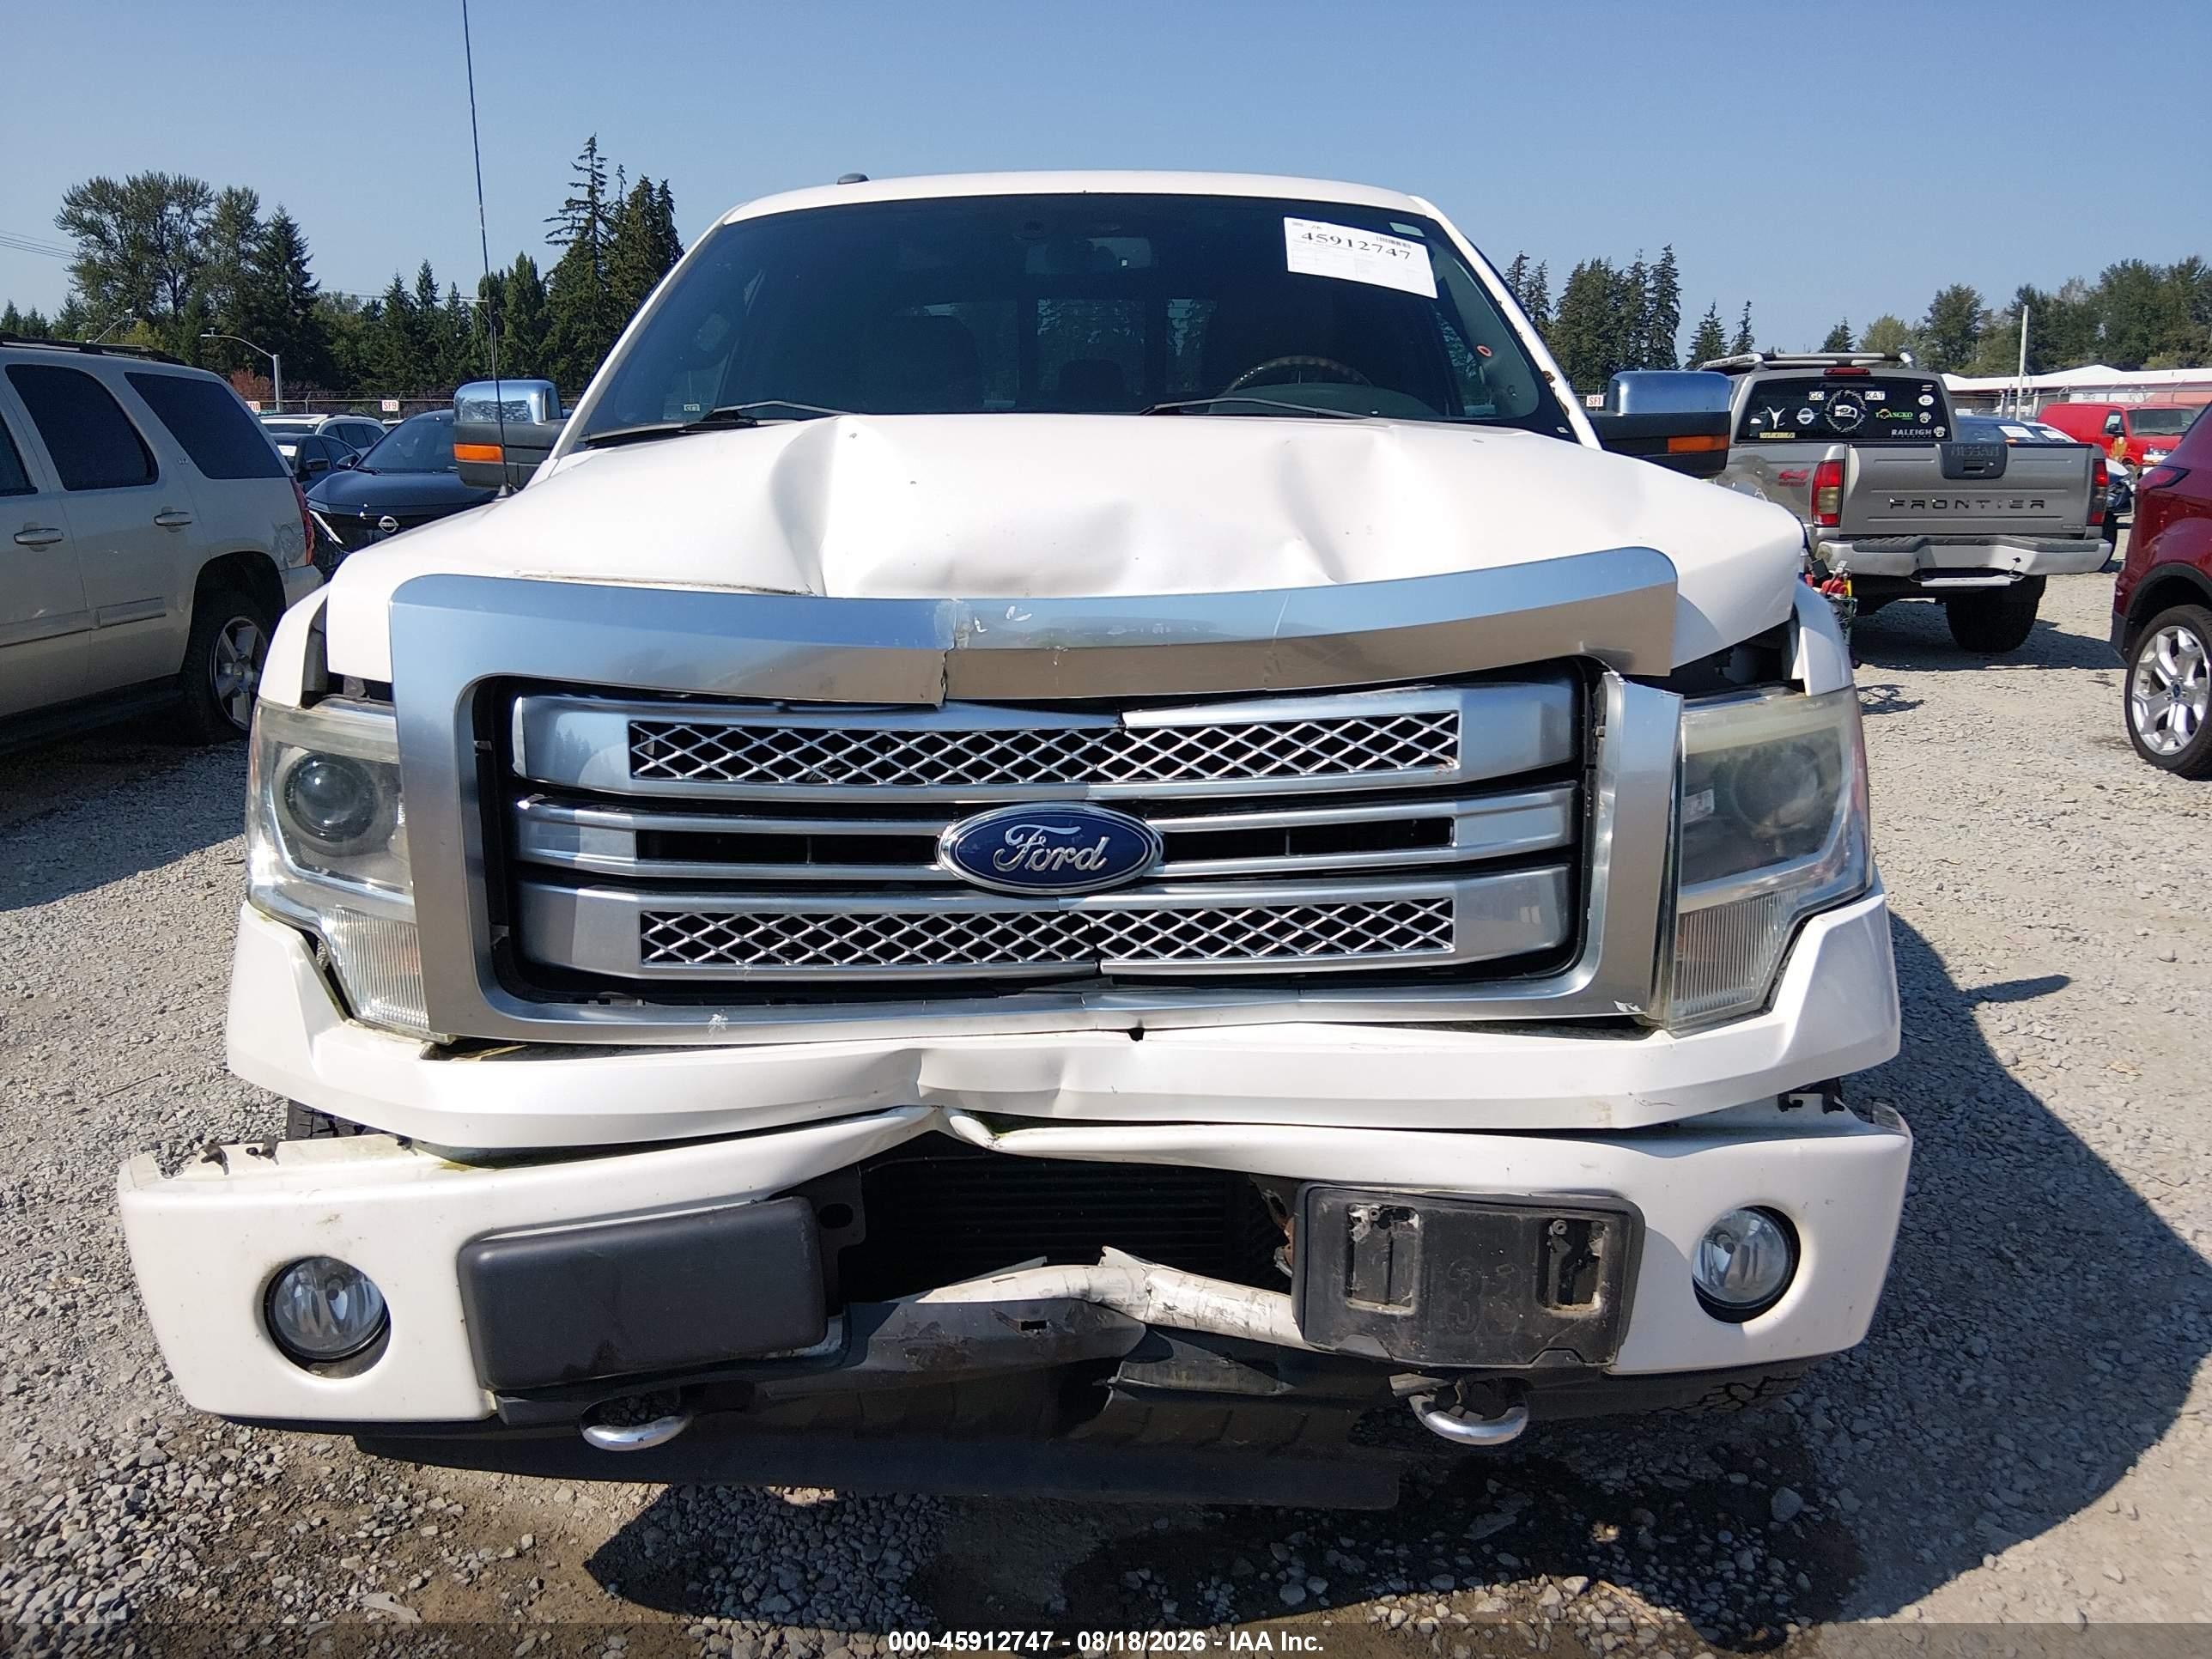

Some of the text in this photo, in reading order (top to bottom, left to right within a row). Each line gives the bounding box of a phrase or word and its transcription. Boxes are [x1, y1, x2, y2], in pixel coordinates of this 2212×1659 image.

[1300, 232, 1412, 260] 45912747
[1809, 392, 1824, 400] GO
[1865, 392, 1885, 400] KAT
[383, 401, 398, 410] SF9
[1589, 397, 1601, 406] SF1
[1889, 499, 2045, 509] FRONTIER
[993, 823, 1111, 872] Ford
